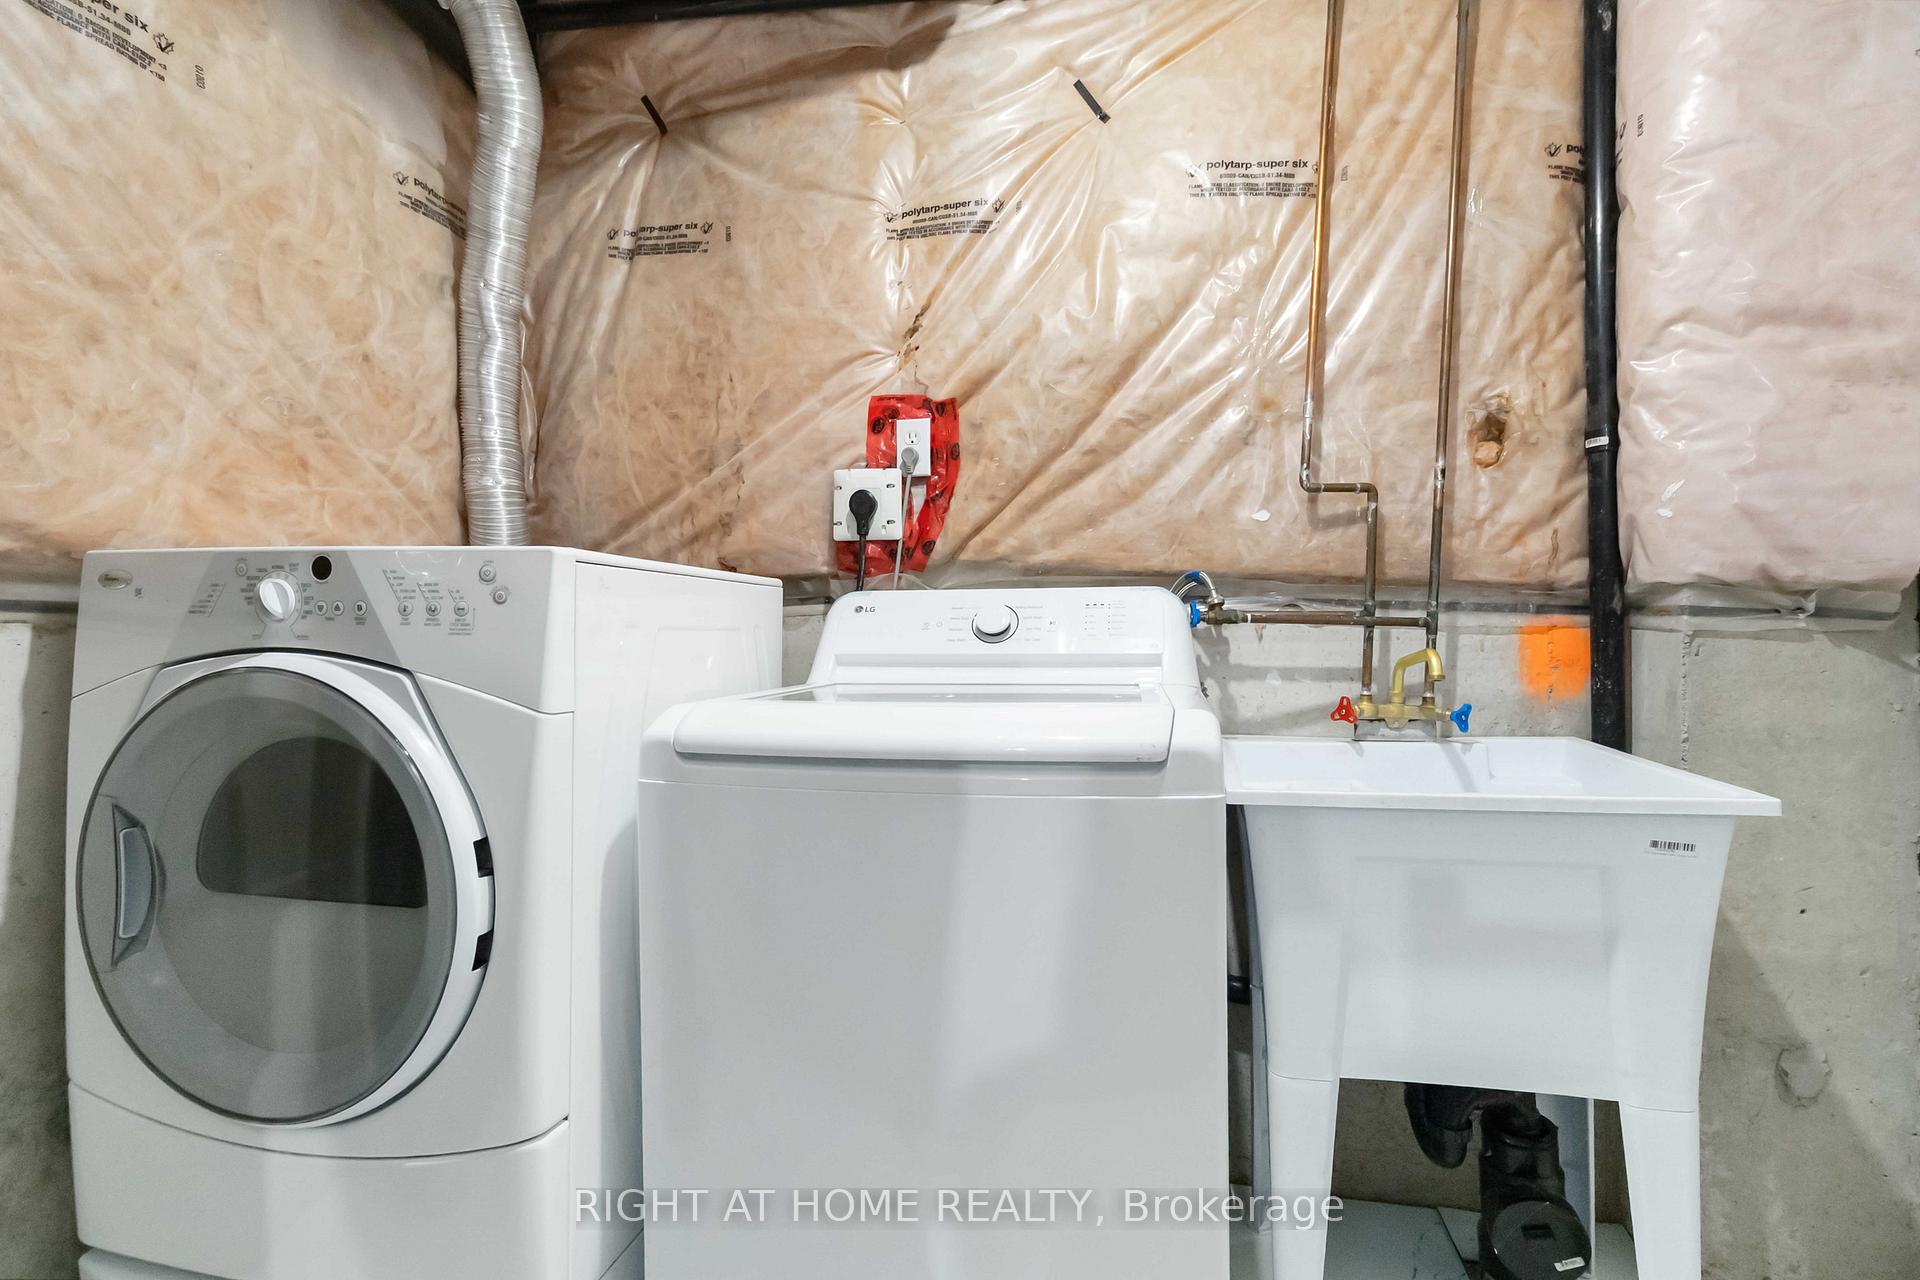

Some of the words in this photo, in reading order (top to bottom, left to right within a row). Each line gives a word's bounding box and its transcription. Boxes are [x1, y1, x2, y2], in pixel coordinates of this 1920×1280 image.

[124, 12, 149, 33] six
[1206, 160, 1290, 171] polytarp-super
[1291, 158, 1309, 169] six
[901, 200, 972, 220] polytarp-super
[973, 197, 990, 207] six
[684, 220, 698, 231] six
